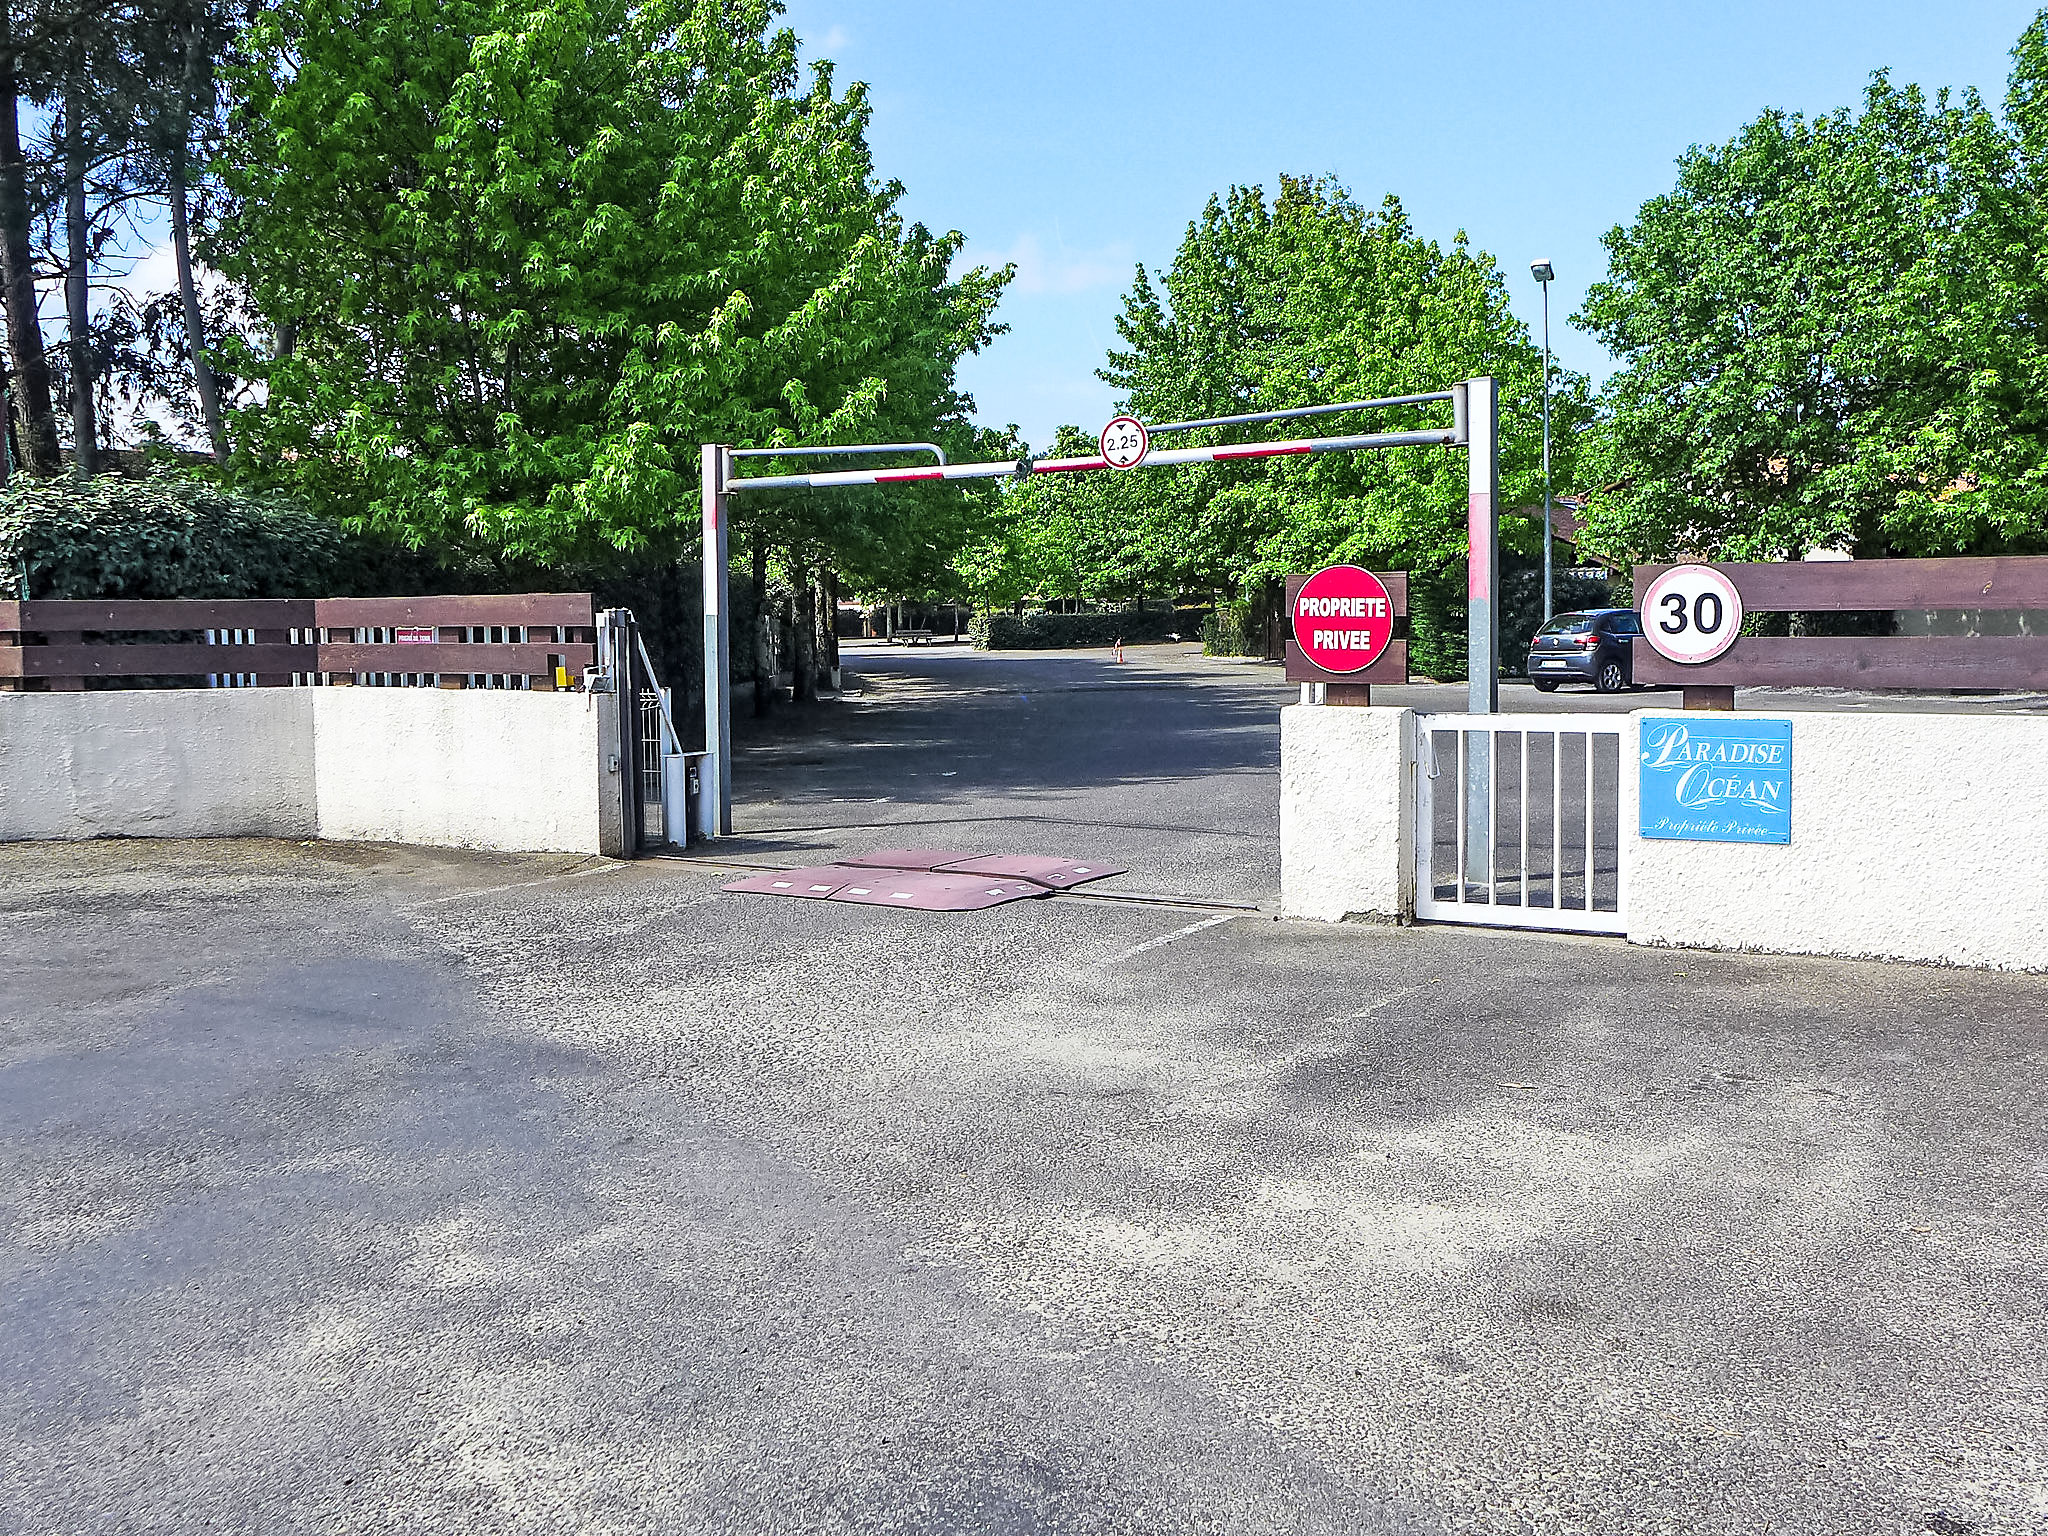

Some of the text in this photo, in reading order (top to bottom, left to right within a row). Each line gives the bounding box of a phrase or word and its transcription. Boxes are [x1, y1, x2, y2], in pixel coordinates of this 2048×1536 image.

[1107, 435, 1138, 451] 2.25
[1299, 597, 1386, 617] PROPRIETE
[1659, 592, 1723, 634] 30
[1313, 629, 1371, 650] PRIVEE
[1640, 722, 1785, 769] PARADISE
[1675, 761, 1784, 807] OCÉAN
[1654, 817, 1768, 836] Propriété Privée
